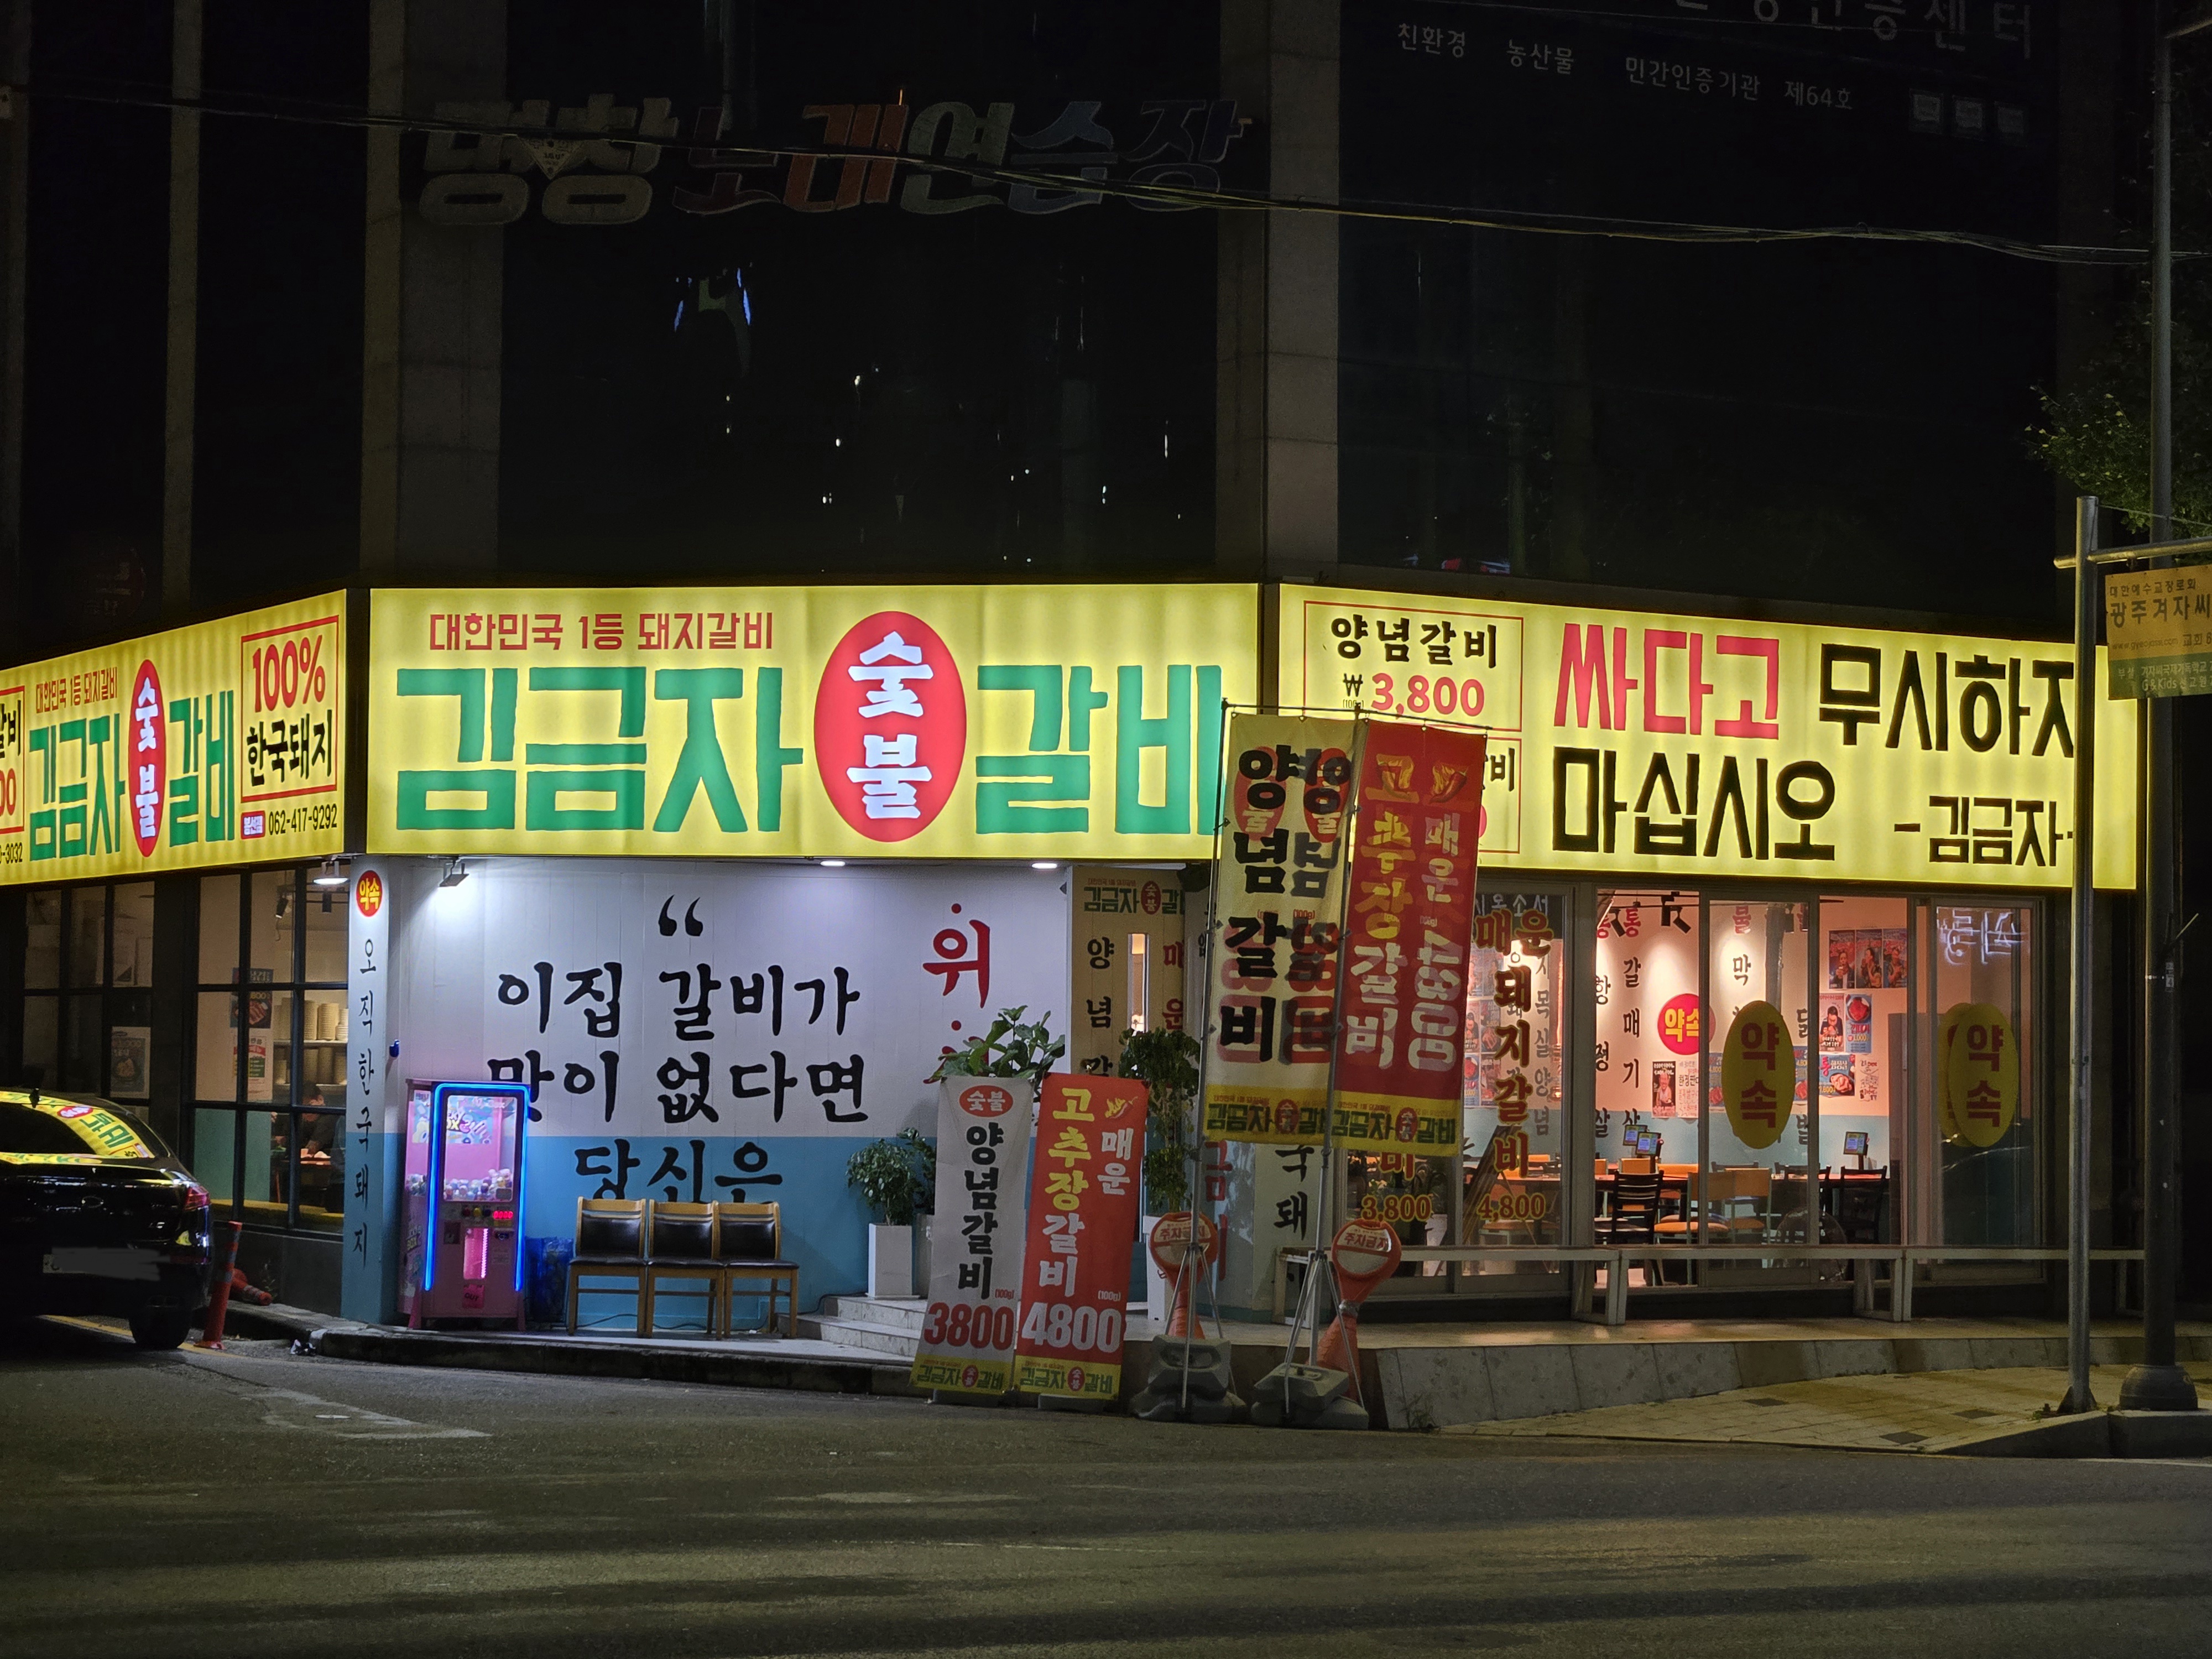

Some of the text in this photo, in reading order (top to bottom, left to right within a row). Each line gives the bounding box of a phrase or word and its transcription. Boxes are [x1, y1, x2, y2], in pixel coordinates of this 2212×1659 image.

[1397, 23, 1853, 109] 친환경 농산물 민간인증기관 제64호
[430, 612, 774, 651] 대한민국 1등 돼지갈비
[2110, 593, 2211, 629] 광주겨자씨
[1331, 613, 1497, 669] 양념갈비
[35, 666, 118, 714] 대한민국 1등 돼지갈비
[252, 634, 326, 713] 100%
[1371, 672, 1485, 720] 3,800
[1553, 622, 1780, 741] 싸다고
[247, 708, 333, 787] 한국돼지
[397, 666, 804, 833] 김금자
[847, 631, 934, 819] 숯불
[975, 664, 1222, 835] 갈비
[29, 676, 235, 862] 김금자 숯불 갈비
[269, 804, 338, 836] 062-417-9292
[1552, 745, 1835, 862] 마십시오
[359, 878, 380, 911] 약속
[1084, 886, 1140, 914] 김금자
[1219, 744, 1301, 1064] 양념갈비
[1474, 908, 1554, 957] 매운
[497, 961, 860, 1041] 이집 갈비가
[656, 1051, 869, 1123] 없다면
[1493, 964, 1533, 1178] 돼지갈비
[1740, 1022, 1780, 1129] 약속
[1966, 1024, 2004, 1128] 약속
[967, 1091, 1006, 1113] 숯불
[1207, 1104, 1275, 1133] 김금자
[1332, 1109, 1396, 1140] 김금자
[1417, 1117, 1456, 1144] 갈비
[575, 1138, 783, 1203] 당신은
[1097, 1127, 1134, 1196] 매운
[958, 1121, 1004, 1300] 양념갈비
[1039, 1087, 1095, 1298] 고추장갈비
[1361, 1193, 1432, 1223] 3,800
[1476, 1192, 1547, 1222] 4,800
[995, 1288, 1015, 1300] (100g)
[1097, 1290, 1122, 1301] (100g)
[924, 1301, 1015, 1350] 3800
[1021, 1302, 1121, 1353] 4800
[916, 1365, 962, 1386] 김금자
[977, 1370, 1005, 1390] 갈비
[1019, 1366, 1067, 1389] 김금자
[1084, 1373, 1114, 1394] 갈비
